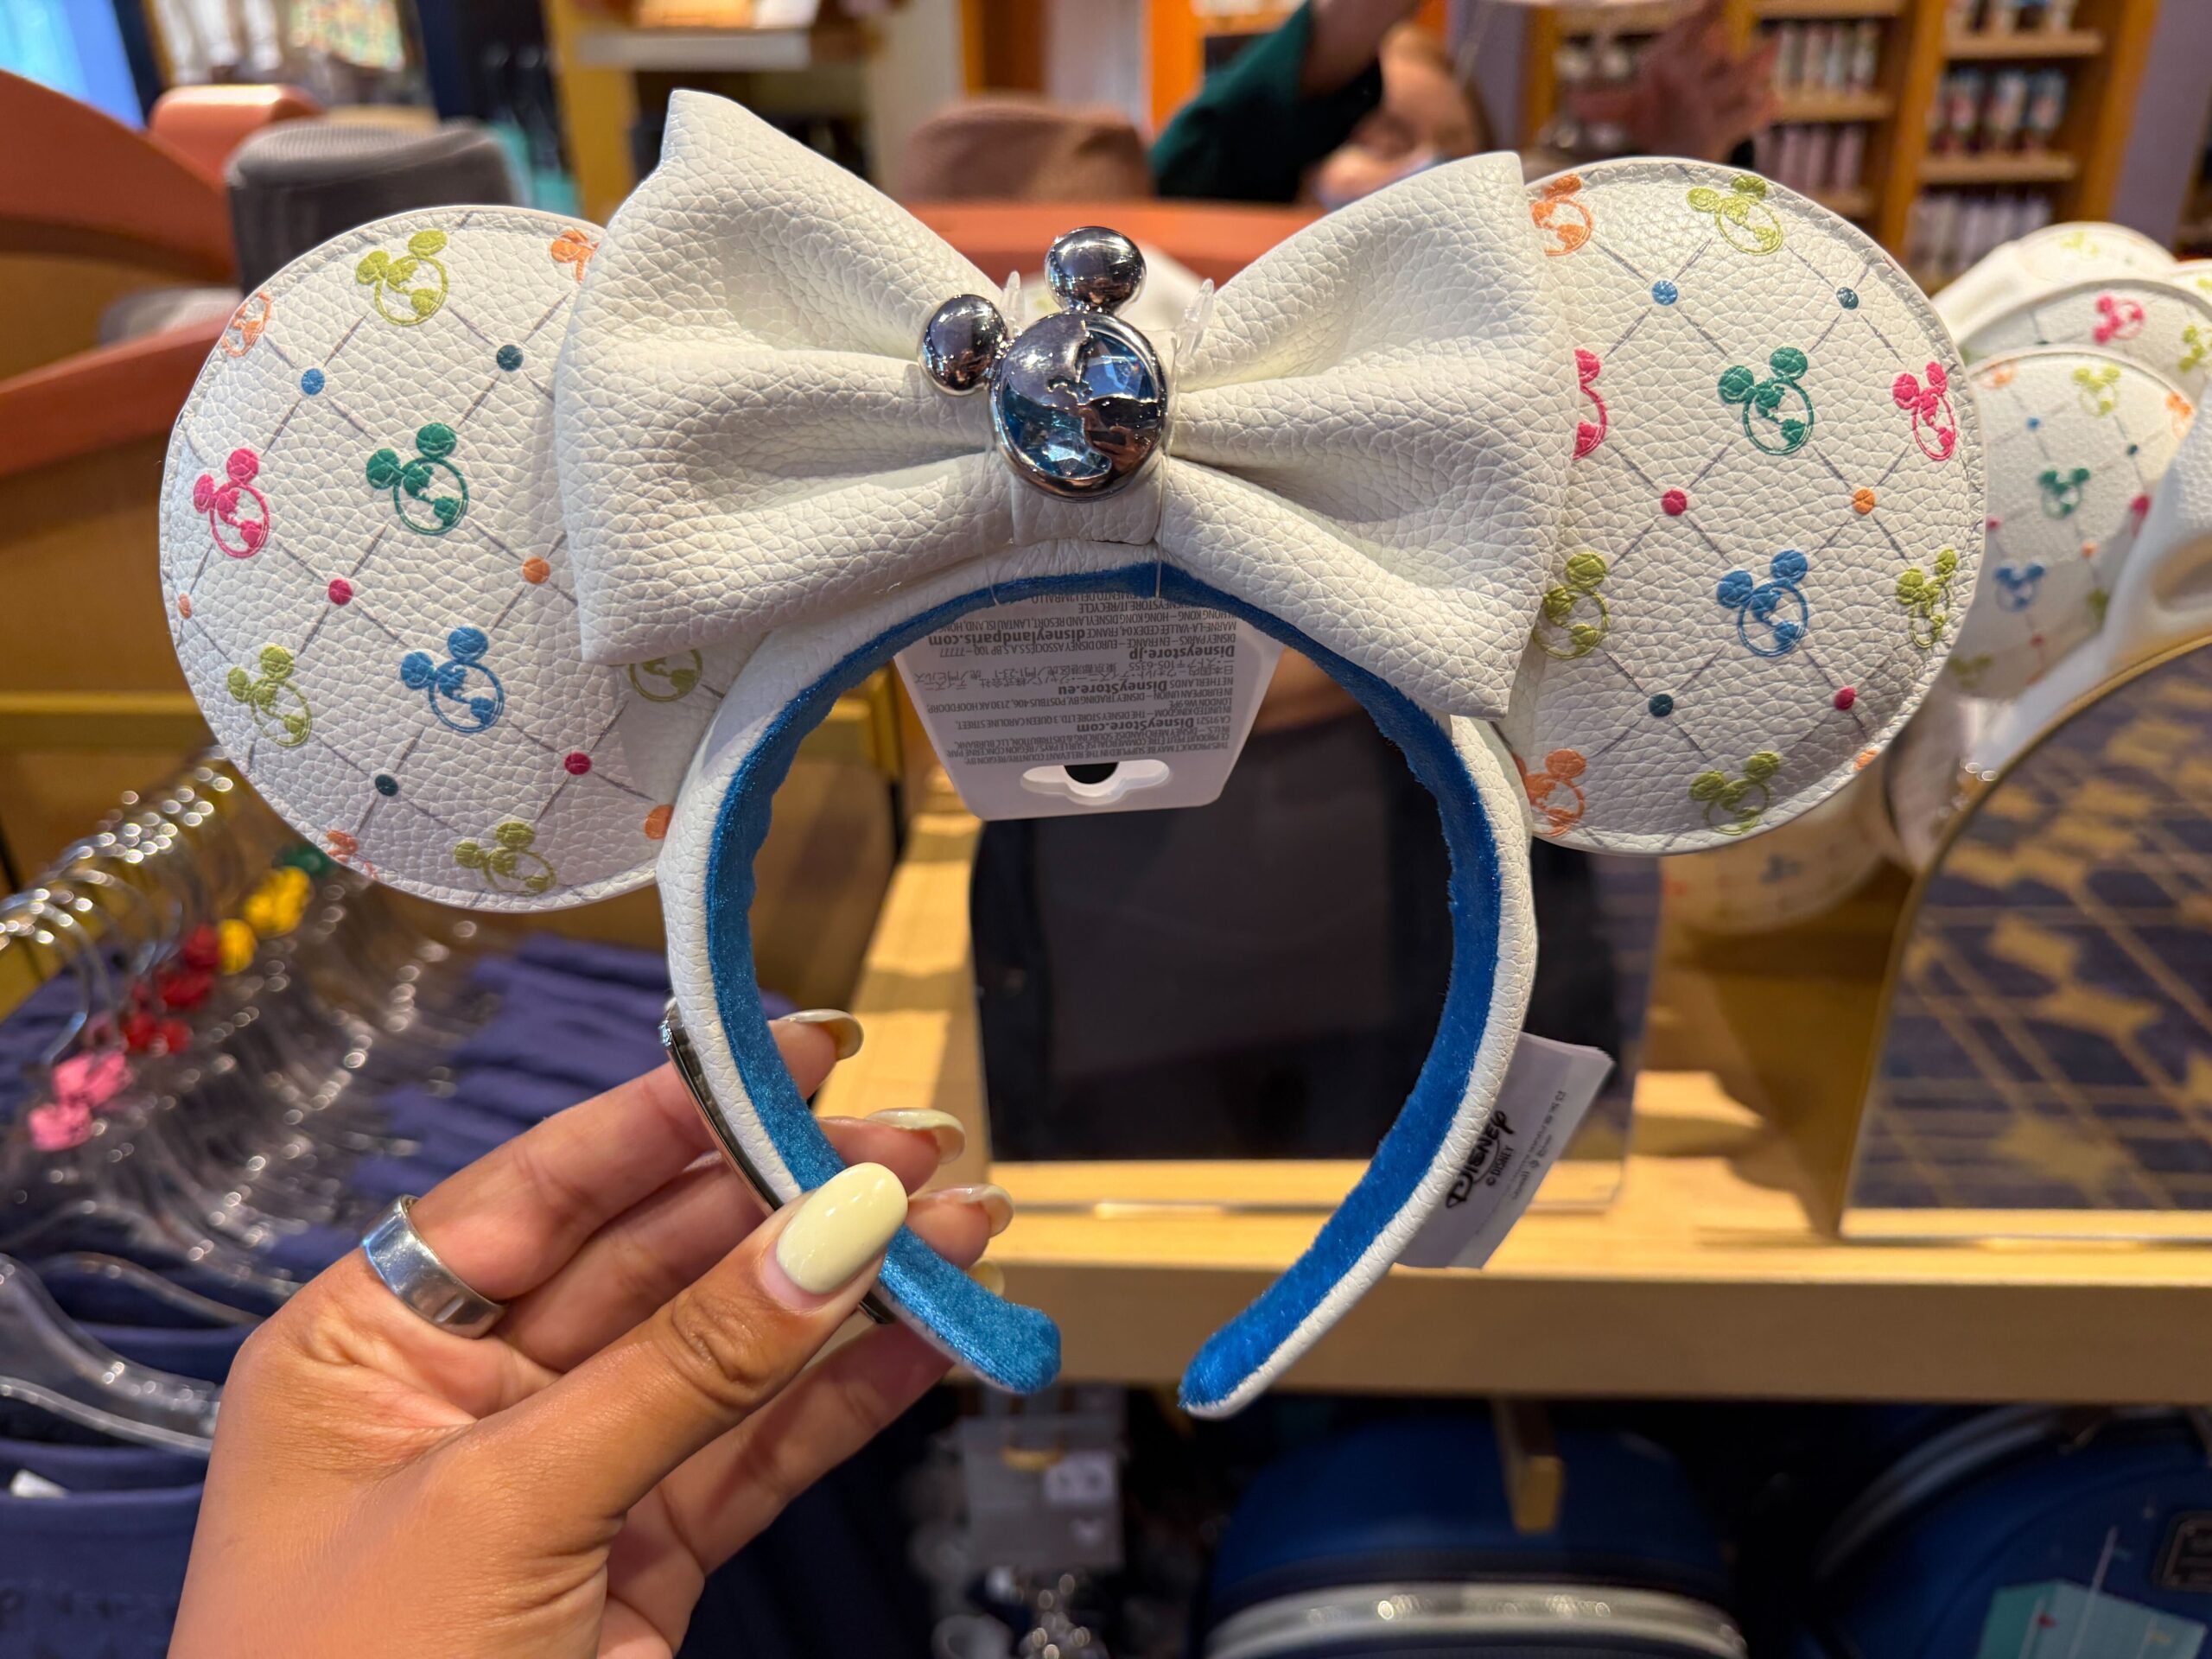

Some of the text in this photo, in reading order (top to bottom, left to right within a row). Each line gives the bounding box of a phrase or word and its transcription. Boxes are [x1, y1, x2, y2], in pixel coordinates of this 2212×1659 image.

[1065, 613, 1118, 627] DISNEYLAND
[1120, 613, 1142, 624] KONG
[1144, 612, 1168, 622] HONG
[1178, 610, 1201, 621] KONG
[999, 619, 1030, 631] LANTAU
[1134, 624, 1159, 636] CEDEX
[928, 627, 1085, 647] disneylandparis.com
[1087, 627, 1118, 639] FRANCE
[1206, 632, 1236, 645] DISNEY
[1096, 639, 1117, 650] EURO
[1127, 638, 1158, 648] FRANCE
[1160, 636, 1170, 646] EN
[1179, 634, 1205, 646] PARKS
[990, 645, 1001, 655] BP
[1065, 640, 1094, 652] DISNEY
[1129, 643, 1235, 662] Disneystore.jp
[1058, 677, 1234, 695] NETHERLANDS DisneyStore.eu
[1117, 693, 1145, 703] DISNEY
[1154, 690, 1179, 700] UNION
[1180, 688, 1223, 698] EUROPEAN
[1030, 696, 1065, 708] POSTBUS
[1080, 693, 1115, 705] TRADING
[1199, 697, 1232, 707] LONDON
[978, 702, 990, 710] AK
[1077, 712, 1101, 722] STORE
[1102, 711, 1130, 721] DISNEY
[1132, 710, 1145, 719] THE
[987, 717, 1025, 728] CAROLINE
[1026, 715, 1052, 726] QUEEN
[1077, 717, 1194, 732] DisneyStore.com
[1046, 750, 1084, 760] RELEVANT
[1491, 1146, 1514, 1177] DISNEY
